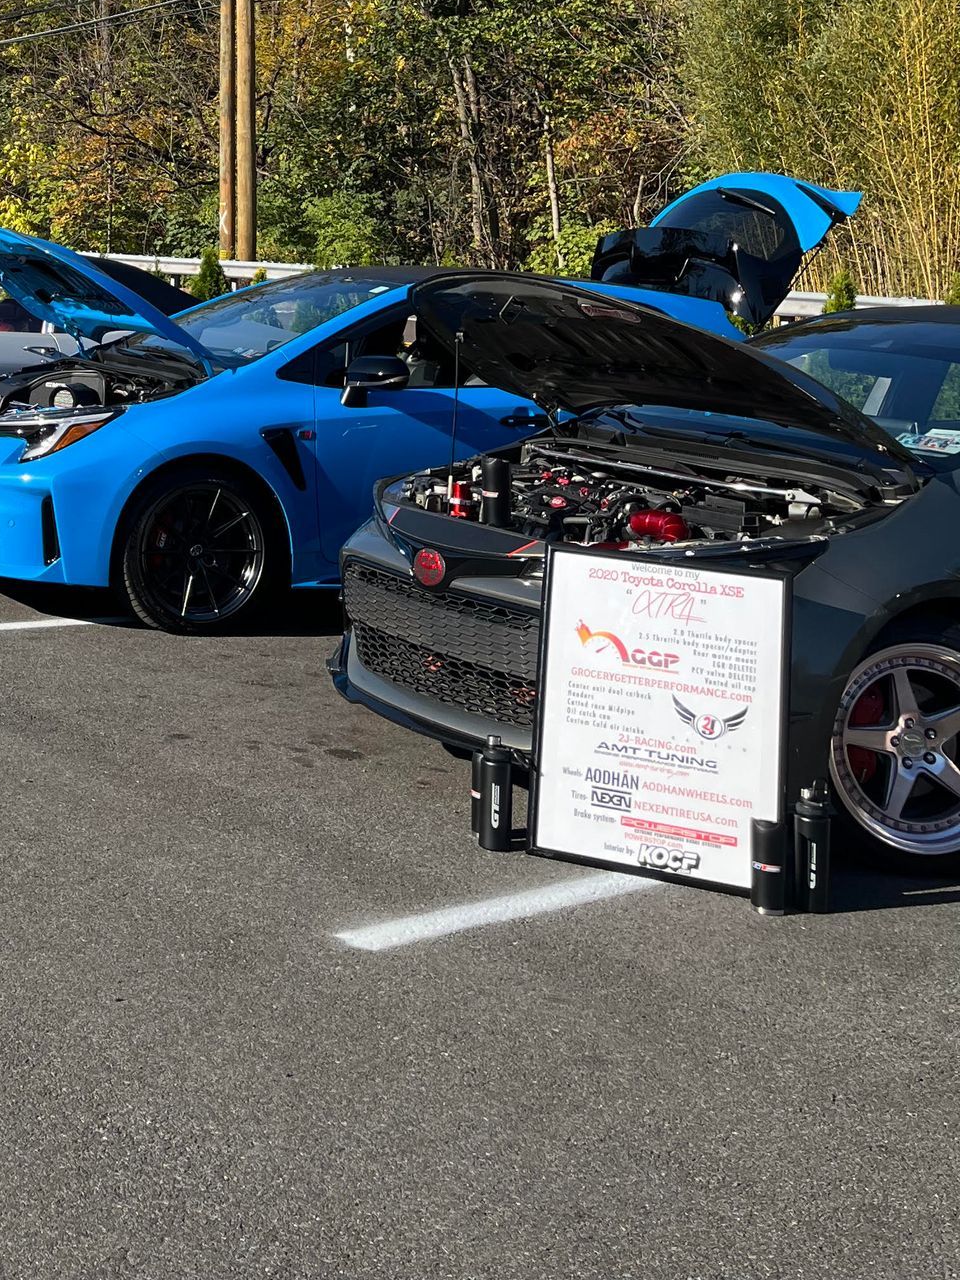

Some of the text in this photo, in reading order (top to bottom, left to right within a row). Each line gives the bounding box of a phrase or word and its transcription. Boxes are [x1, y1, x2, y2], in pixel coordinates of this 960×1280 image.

[631, 563, 700, 581] Welcome to my
[589, 568, 745, 598] 2020 Toyota Corolla XSE
[639, 632, 650, 640] 2.5
[653, 634, 680, 645] Throttle
[683, 638, 700, 648] body
[715, 634, 732, 644] body
[735, 638, 757, 648] spacer
[693, 649, 757, 665] Rear motor mount
[712, 660, 726, 670] EGR
[691, 666, 704, 676] PCV
[707, 669, 725, 678] valve
[568, 680, 652, 701] Center exit dual catback
[571, 666, 753, 704] GROCERYGETTERPERFORMANCE.com
[704, 677, 756, 693] Vented oil cap
[567, 690, 594, 700] Headers
[567, 706, 577, 715] Oil
[579, 709, 597, 718] catch
[608, 705, 635, 716] Midpipe
[566, 715, 590, 726] Custom
[592, 720, 607, 729] Cold
[618, 733, 697, 754] 2J-RACING.com
[597, 741, 718, 769] AMT TUNING
[621, 753, 676, 767] PERFORMANCE
[677, 763, 719, 775] SOFTWARE
[642, 781, 753, 809] AODHANWHEELS.com
[591, 790, 632, 808] NEXEN
[634, 800, 738, 828] NEXENTIREUSA.com
[573, 807, 592, 819] Brake
[622, 817, 737, 846] POWERSTOP
[604, 842, 624, 854] Interior
[624, 832, 683, 850] POWERSTOP.com
[637, 844, 701, 870] KOCF
